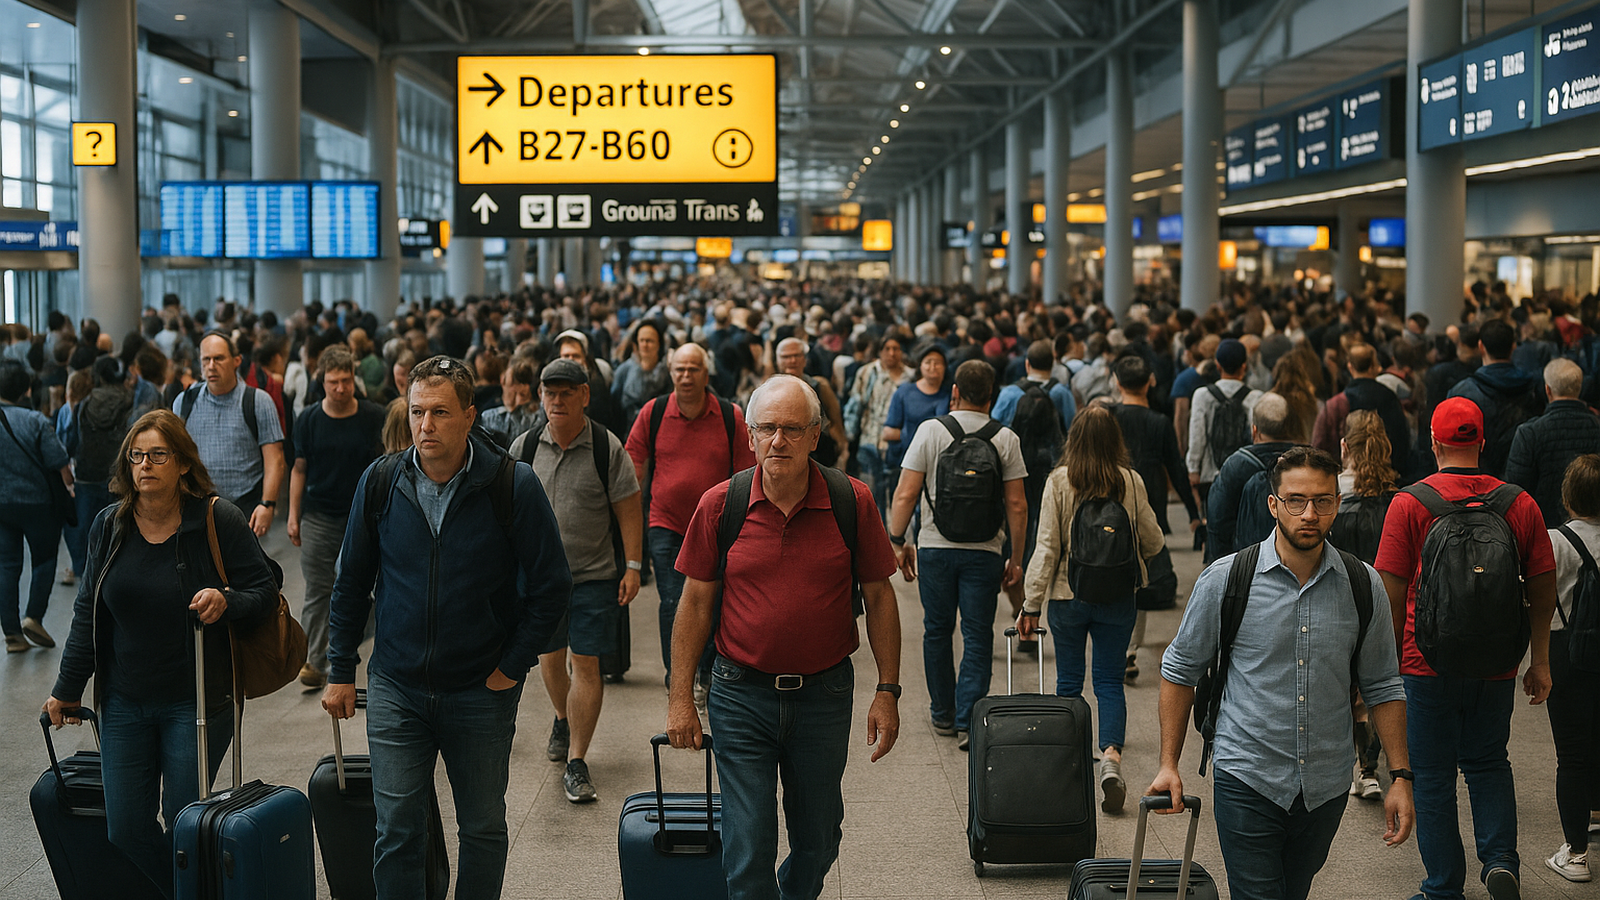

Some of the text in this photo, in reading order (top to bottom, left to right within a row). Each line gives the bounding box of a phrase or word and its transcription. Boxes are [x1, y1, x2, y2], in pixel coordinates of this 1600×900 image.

[519, 76, 733, 117] Departures
[520, 130, 670, 160] B27-B60
[683, 199, 740, 222] Trans
